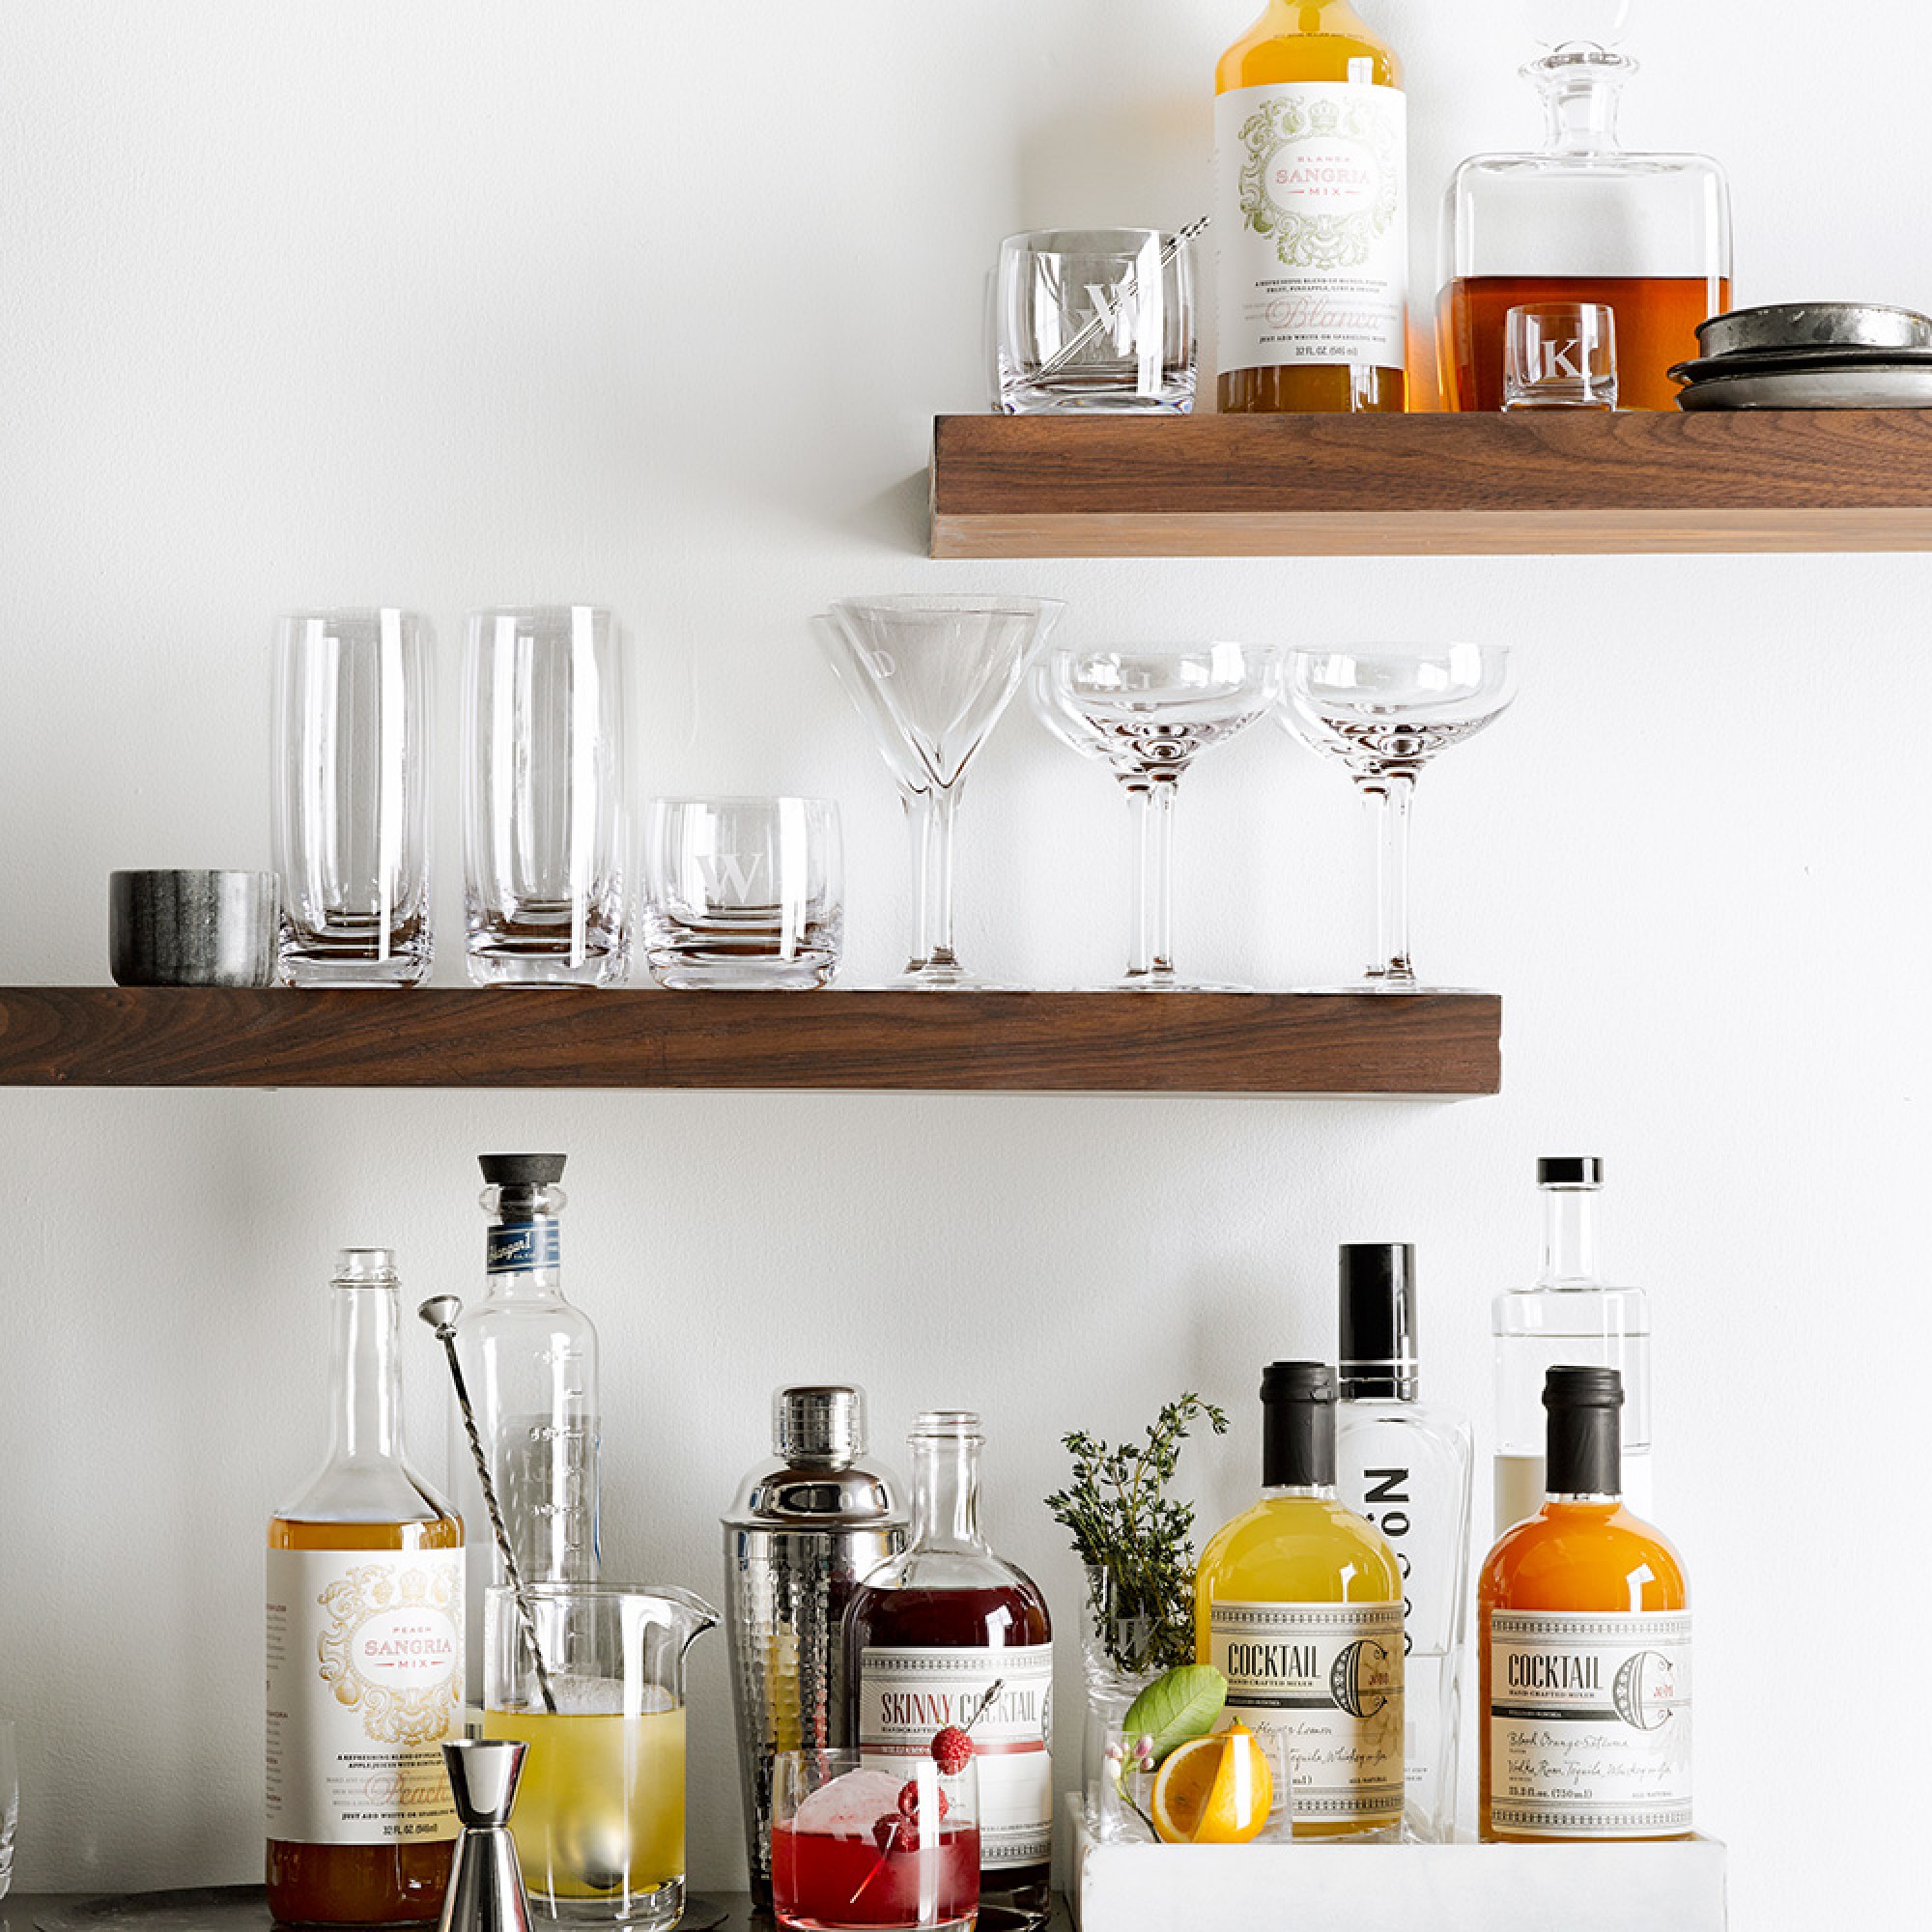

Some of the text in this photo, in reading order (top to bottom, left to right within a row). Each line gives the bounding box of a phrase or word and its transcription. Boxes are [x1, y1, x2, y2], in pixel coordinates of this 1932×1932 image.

[1275, 168, 1370, 185] SANGRIA
[1309, 186, 1341, 196] MIX
[1264, 295, 1378, 330] Blanca
[1540, 339, 1592, 378] K
[695, 852, 764, 904] W
[364, 1637, 453, 1656] SANGRIA
[398, 1659, 428, 1668] MIX
[1228, 1642, 1322, 1680] COCKTAIL
[1508, 1653, 1605, 1690] COCKTAIL
[881, 1691, 955, 1724] SKINNY
